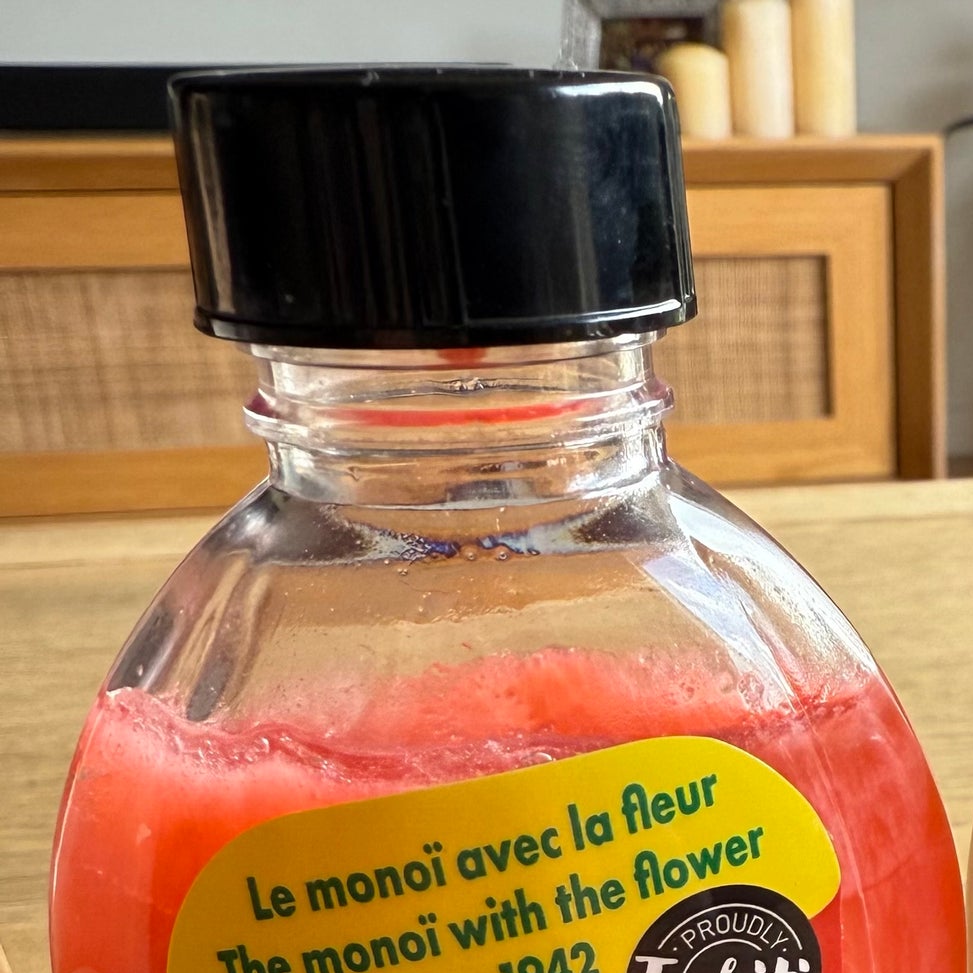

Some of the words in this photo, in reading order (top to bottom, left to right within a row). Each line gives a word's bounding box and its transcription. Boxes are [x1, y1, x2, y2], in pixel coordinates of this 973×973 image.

[247, 876, 295, 921] Le
[305, 845, 447, 911] monoï
[458, 827, 562, 879] avec
[568, 804, 613, 850] la
[621, 773, 718, 838] fleur
[448, 891, 547, 944] with
[555, 874, 627, 924] the
[634, 827, 763, 899] flower
[680, 912, 789, 950] PROUDLY
